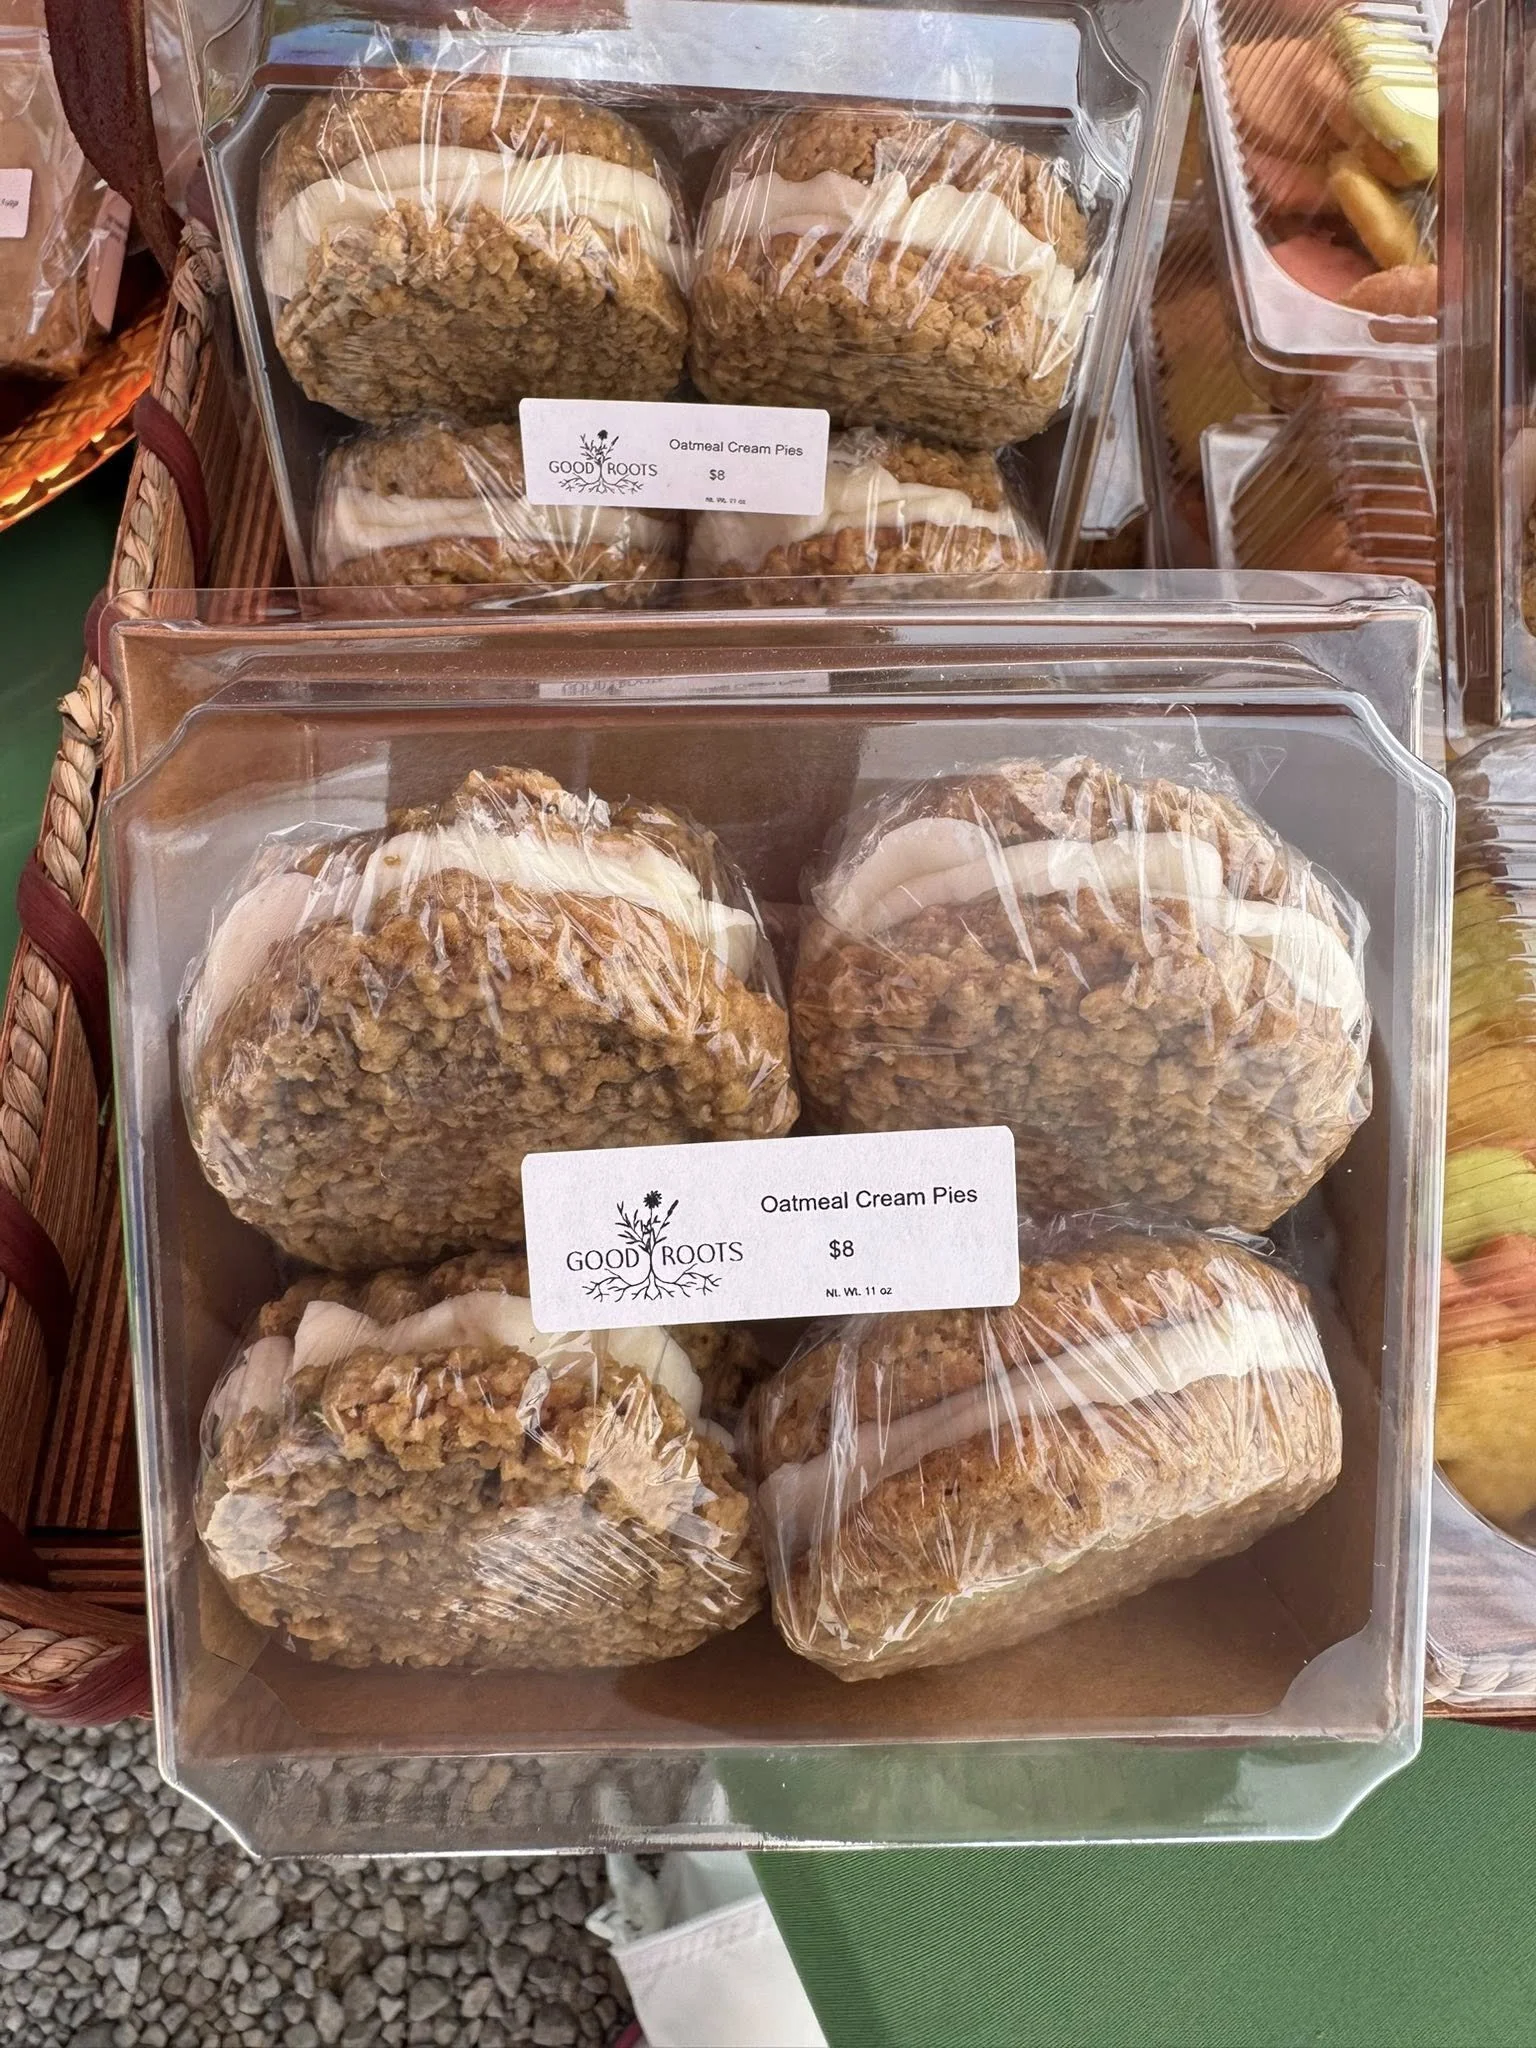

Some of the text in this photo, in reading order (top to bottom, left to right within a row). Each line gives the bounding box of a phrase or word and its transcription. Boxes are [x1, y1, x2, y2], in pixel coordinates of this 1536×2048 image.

[669, 438, 804, 457] Oatmeal Cream Pies
[548, 460, 658, 477] GOOD ROOTS
[709, 468, 726, 481] $8
[761, 1186, 978, 1214] Oatmeal Cream Pies
[566, 1241, 744, 1272] GOOD ROOTS
[829, 1239, 855, 1260] $8
[866, 1286, 876, 1296] 11
[880, 1287, 893, 1296] oz
